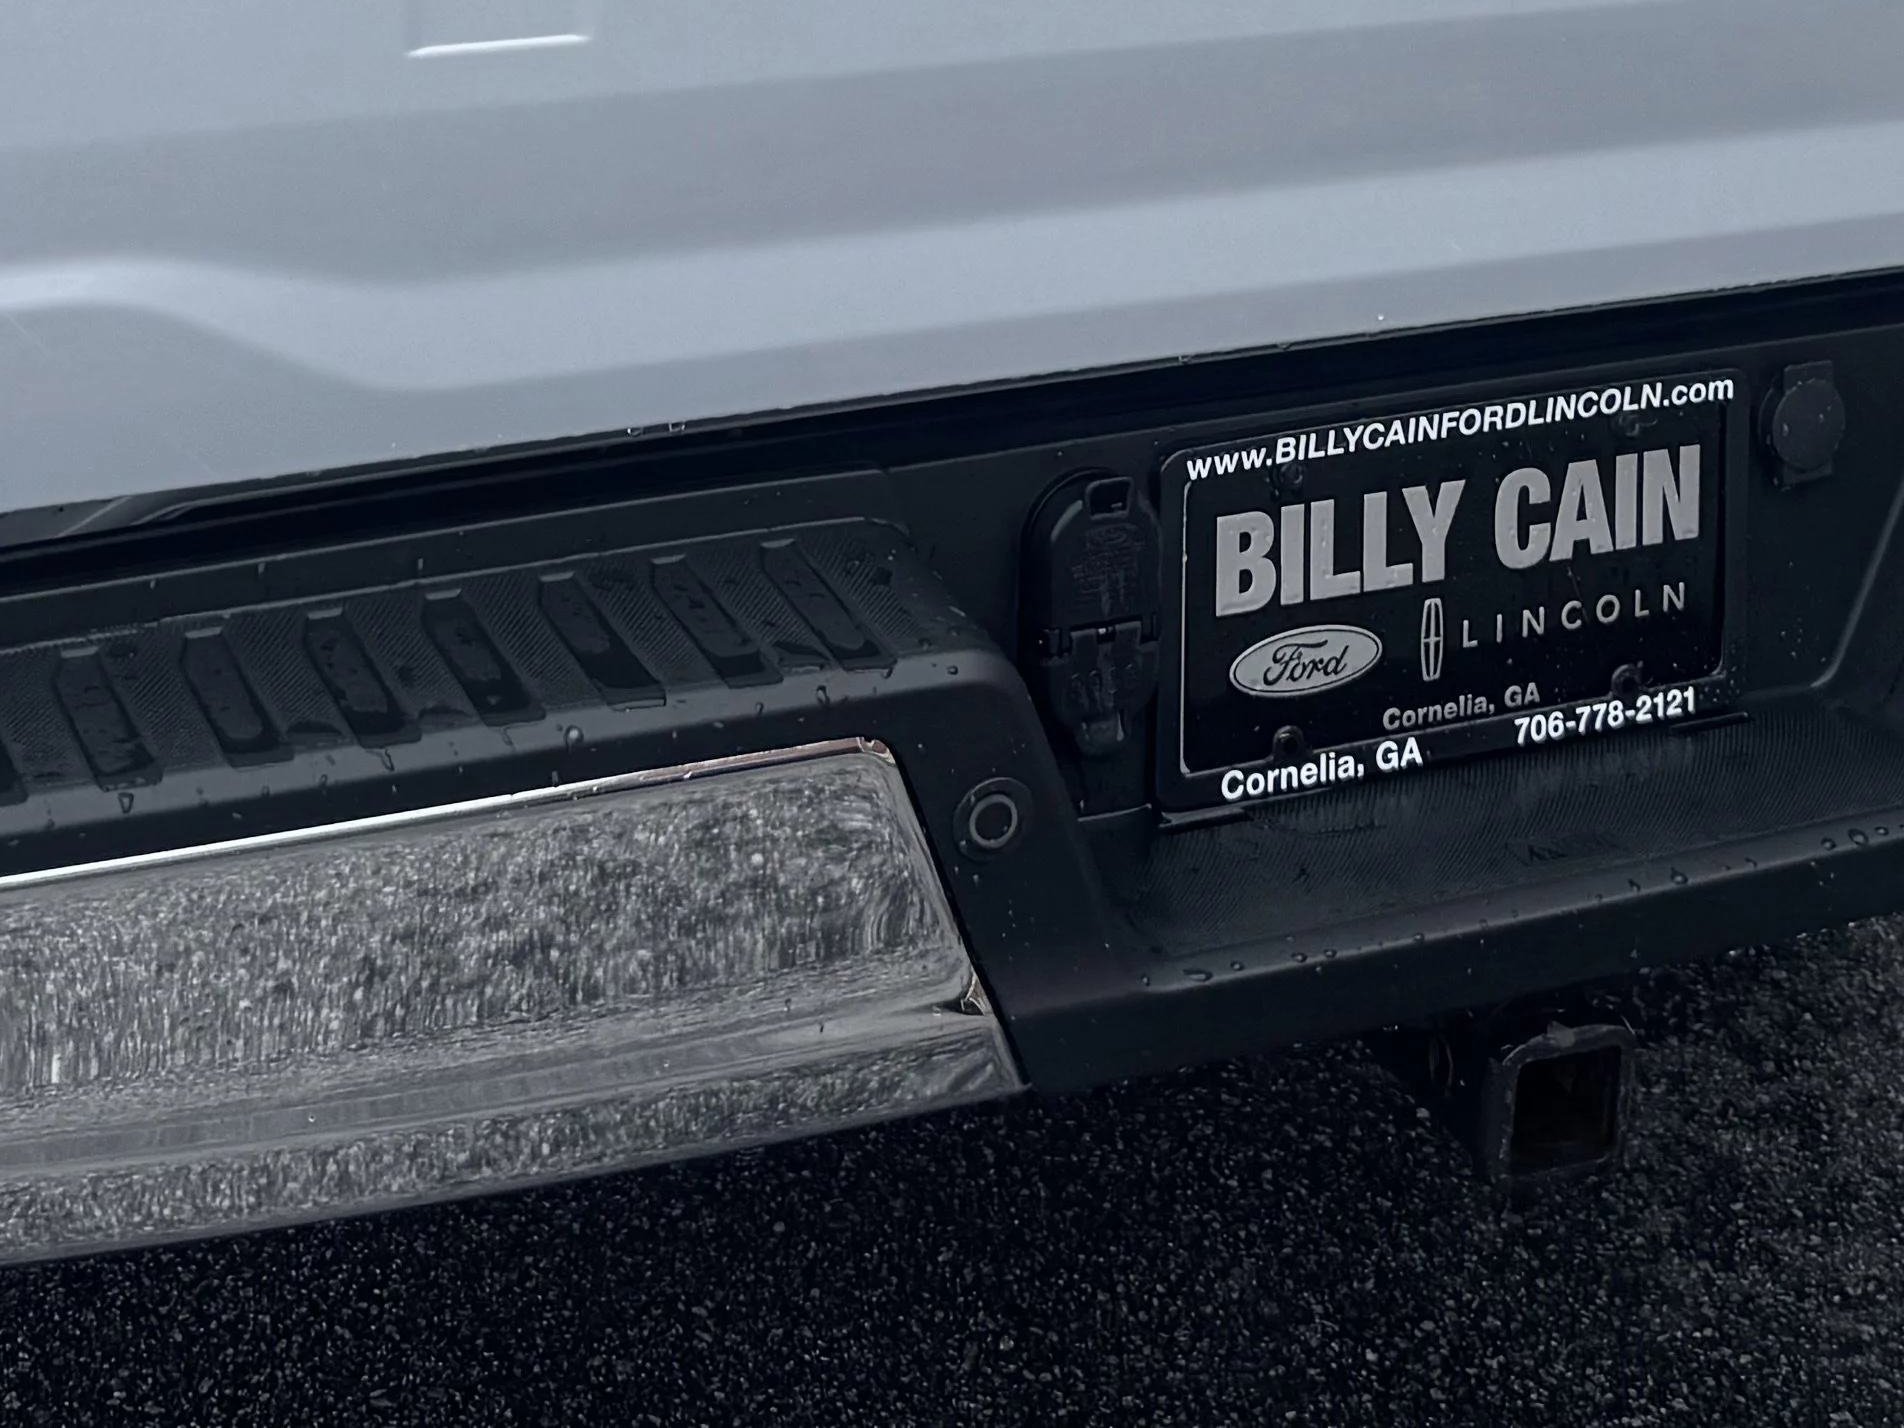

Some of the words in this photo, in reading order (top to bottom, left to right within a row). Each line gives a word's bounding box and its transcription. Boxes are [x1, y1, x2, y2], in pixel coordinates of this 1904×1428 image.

[1186, 378, 1735, 481] www.BILLYCAINFORDLINCOLN.com
[1215, 479, 1466, 617] BILLY
[1494, 444, 1701, 570] CAIN
[1462, 582, 1686, 649] LINCOLN
[1262, 638, 1349, 687] Ford
[1382, 694, 1495, 730] Cornelia,
[1504, 682, 1541, 707] GA
[1514, 687, 1696, 745] 706-778-2121
[1220, 747, 1365, 801] Cornelia,
[1375, 736, 1424, 771] GA
